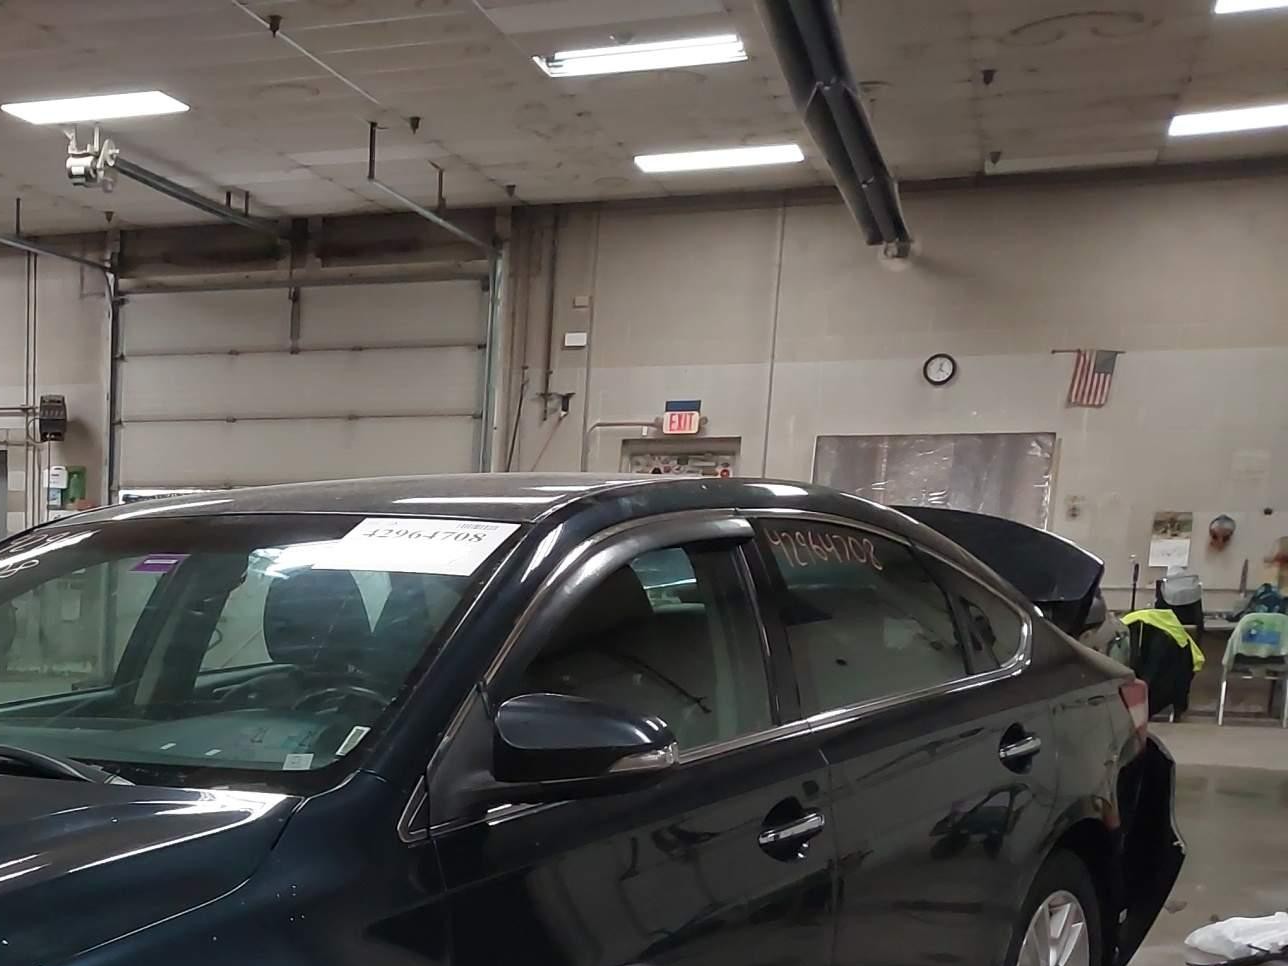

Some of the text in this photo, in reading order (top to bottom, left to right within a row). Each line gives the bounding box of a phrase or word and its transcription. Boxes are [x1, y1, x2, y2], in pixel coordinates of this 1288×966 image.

[668, 412, 695, 432] EXIT
[362, 528, 487, 543] 42964708
[763, 527, 883, 570] 42964708
